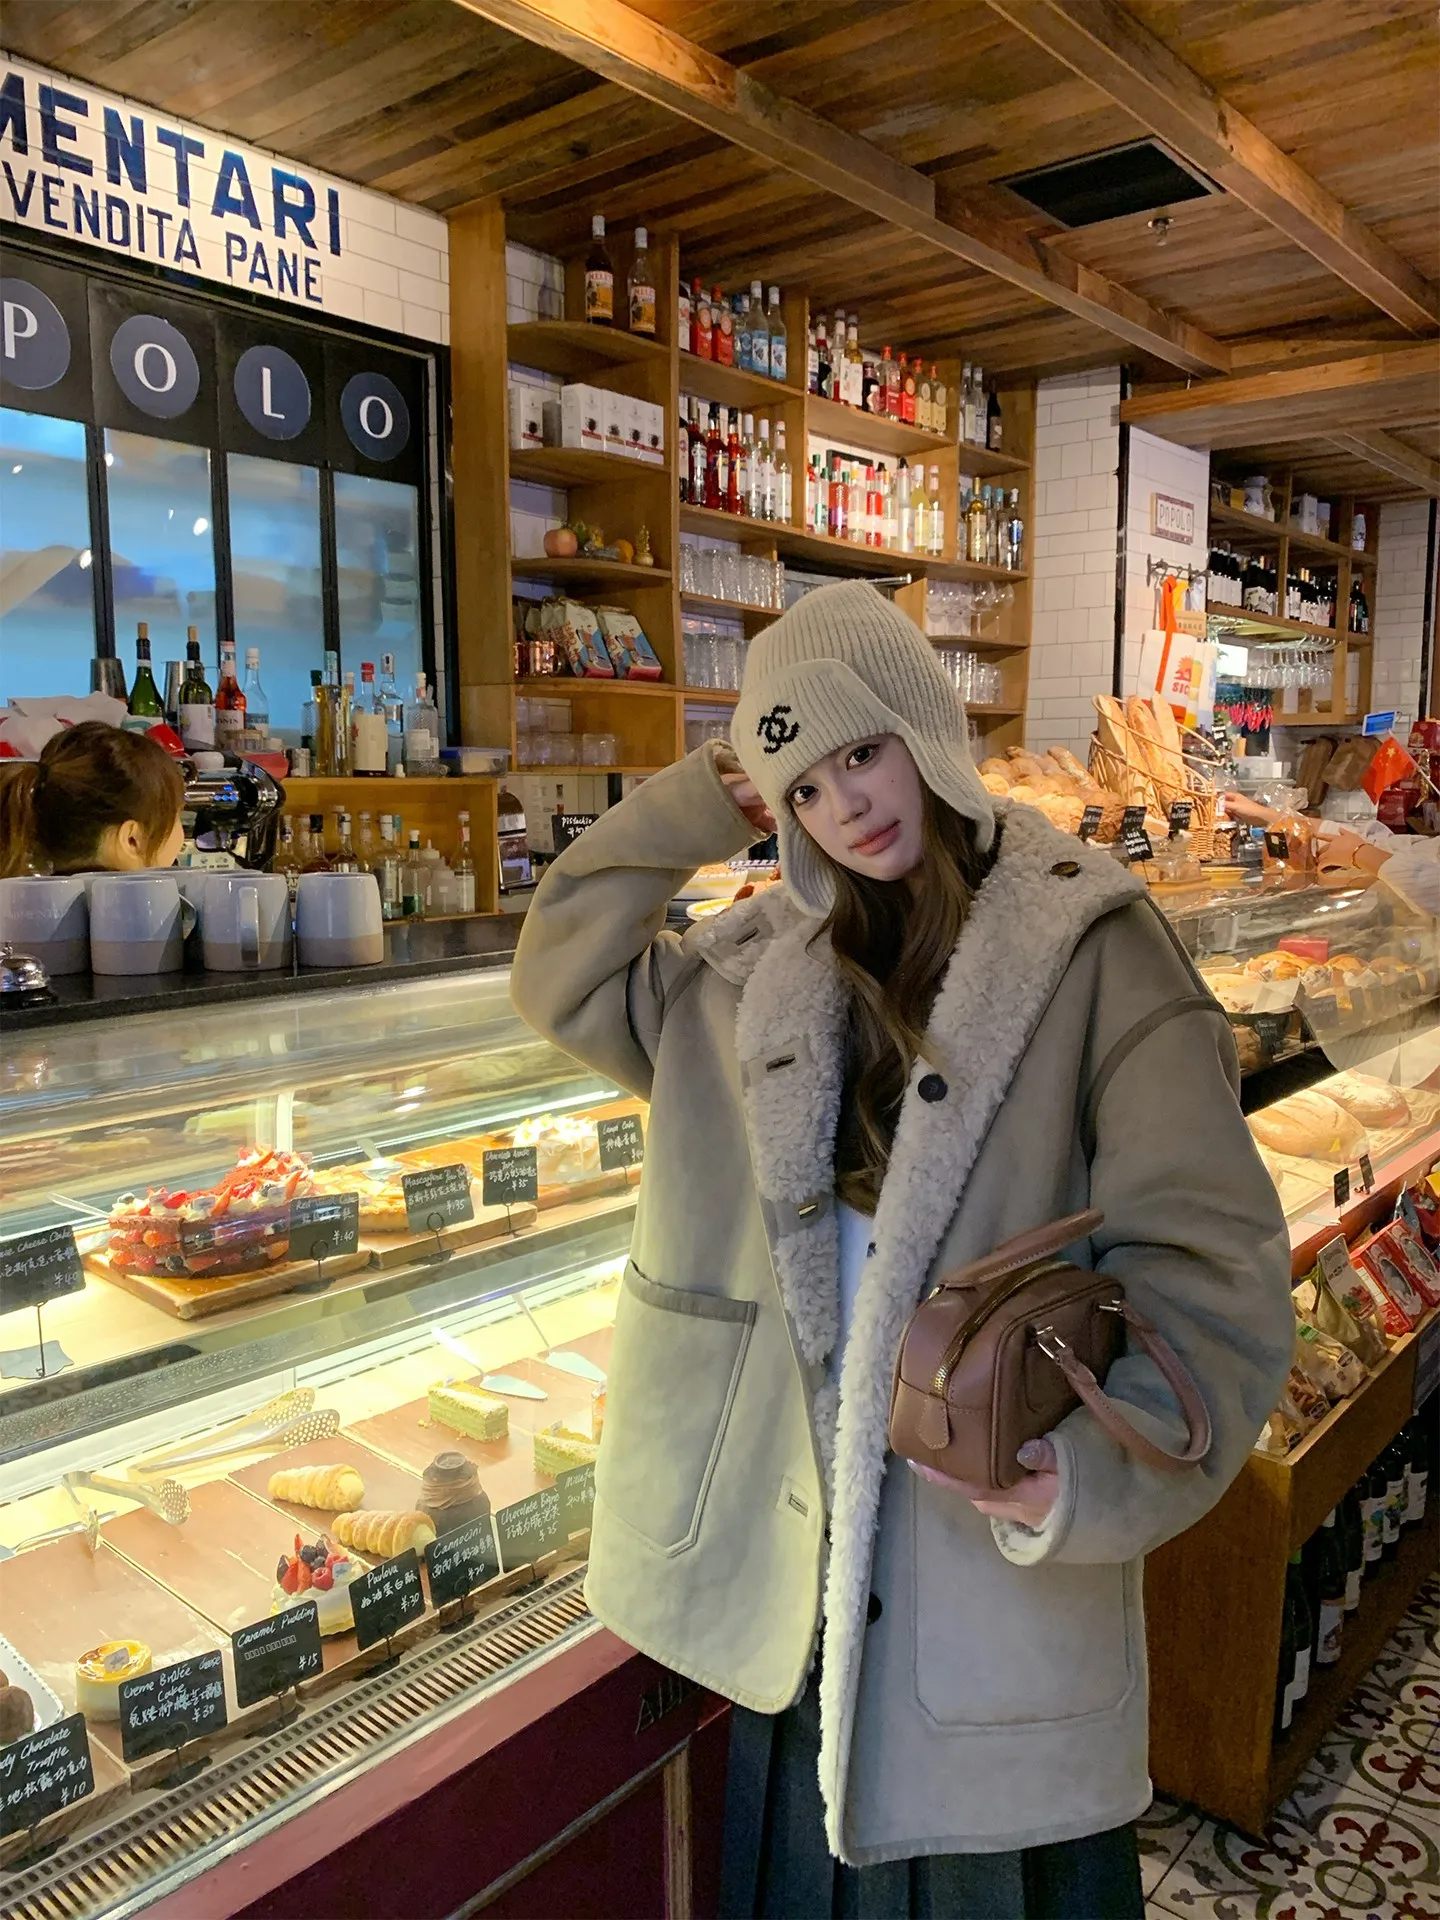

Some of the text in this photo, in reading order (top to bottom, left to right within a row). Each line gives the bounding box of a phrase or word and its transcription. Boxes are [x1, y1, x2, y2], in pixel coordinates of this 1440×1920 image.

[2, 160, 324, 304] VENDITA PANE
[3, 301, 394, 439] P O L O
[1159, 503, 1193, 532] POPOLO
[366, 1564, 399, 1589] Pavlova
[237, 1620, 276, 1648] Caramel
[281, 1607, 316, 1630] Pudding
[20, 1728, 72, 1760] Chocolate
[26, 1745, 70, 1775] Truffle
